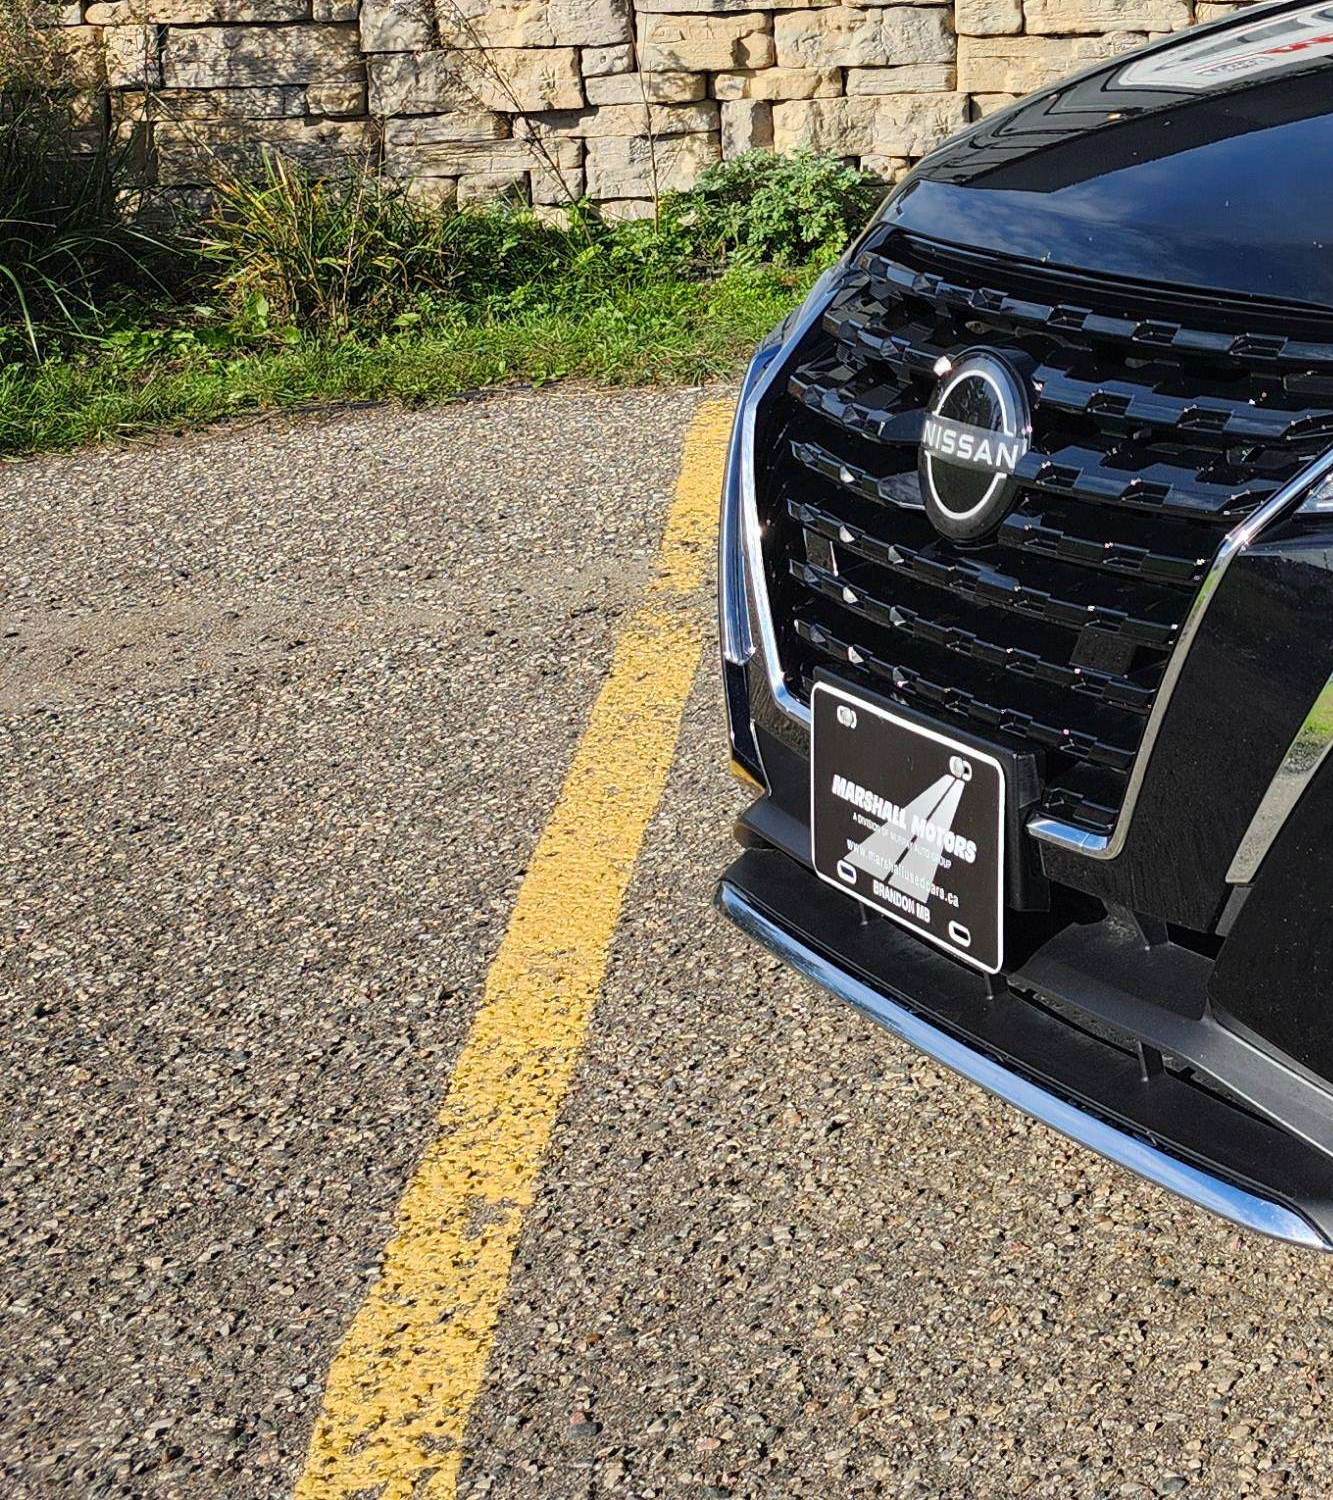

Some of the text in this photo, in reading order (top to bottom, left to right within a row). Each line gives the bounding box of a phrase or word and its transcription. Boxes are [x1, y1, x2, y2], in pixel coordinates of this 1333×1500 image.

[922, 419, 1021, 469] NISSAN
[831, 773, 907, 831] MARSHALL
[910, 814, 978, 864] MOTORS
[873, 879, 931, 923] BRANDON MB
